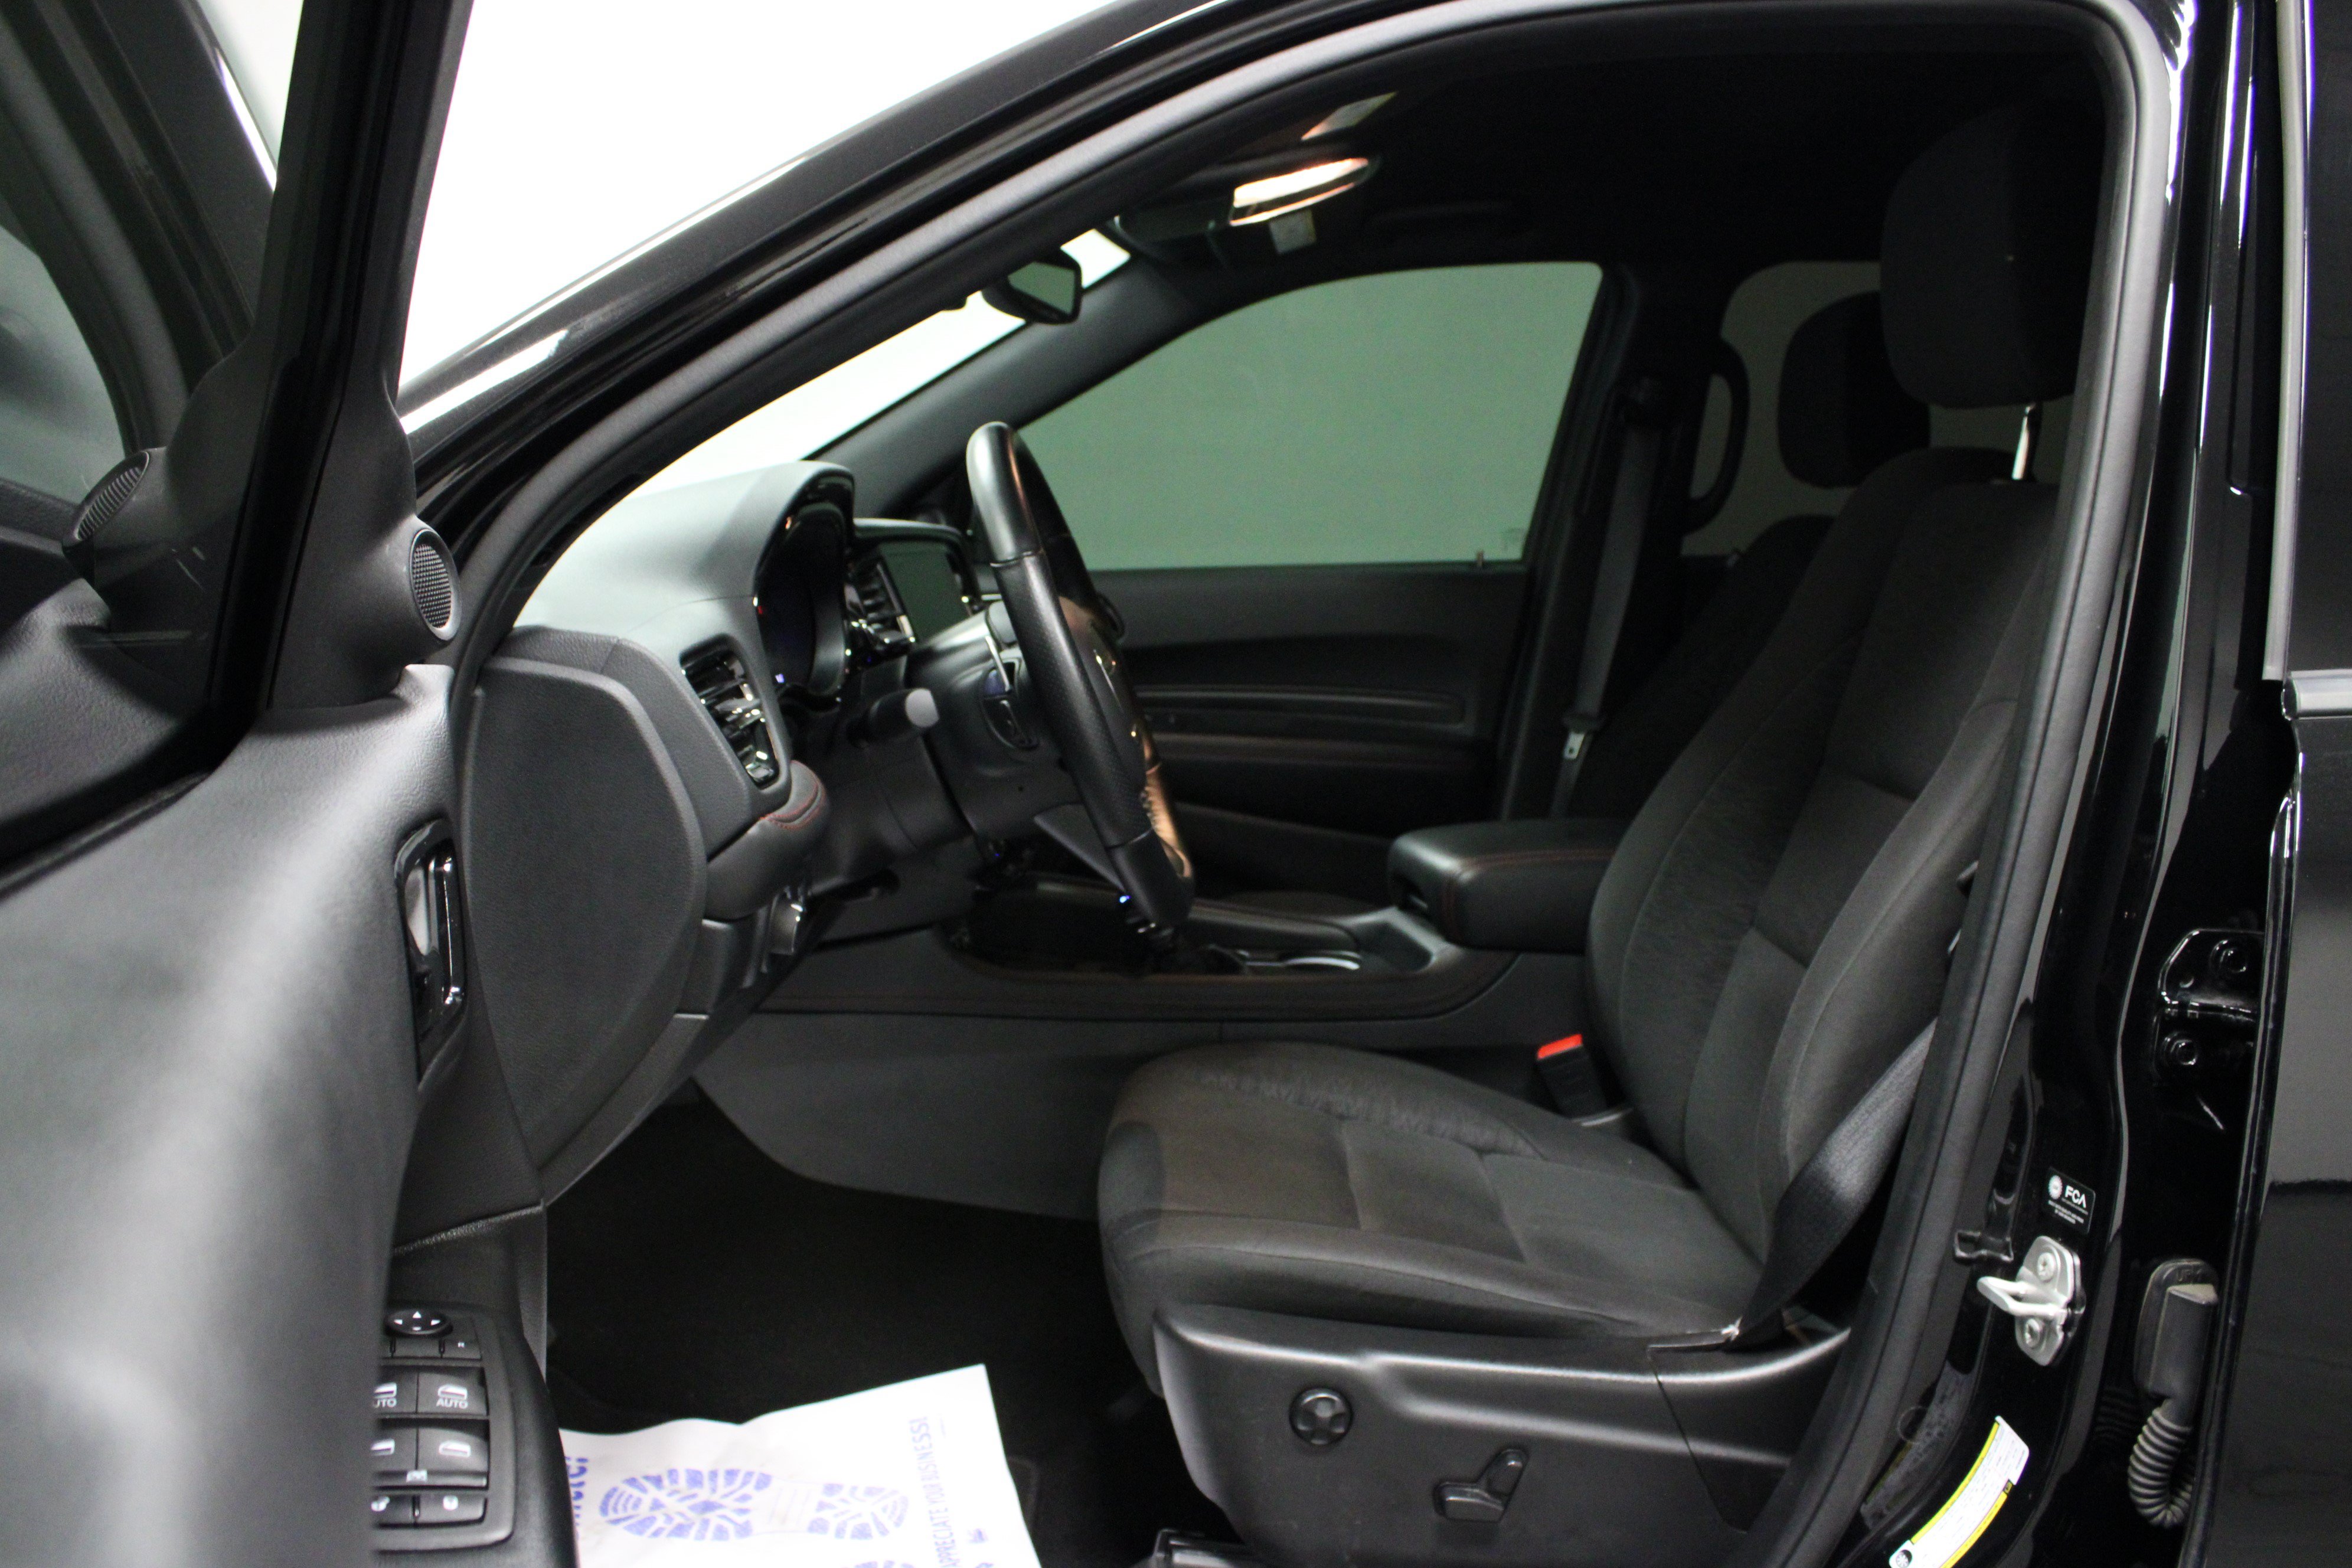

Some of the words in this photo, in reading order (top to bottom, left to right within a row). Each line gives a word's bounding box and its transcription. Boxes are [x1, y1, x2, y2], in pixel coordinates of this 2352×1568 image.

[2064, 1185, 2087, 1208] FCA
[373, 1397, 397, 1408] UTO
[436, 1397, 468, 1409] AUTO
[909, 1416, 940, 1481] BUSINESS!
[922, 1482, 946, 1505] YOUR
